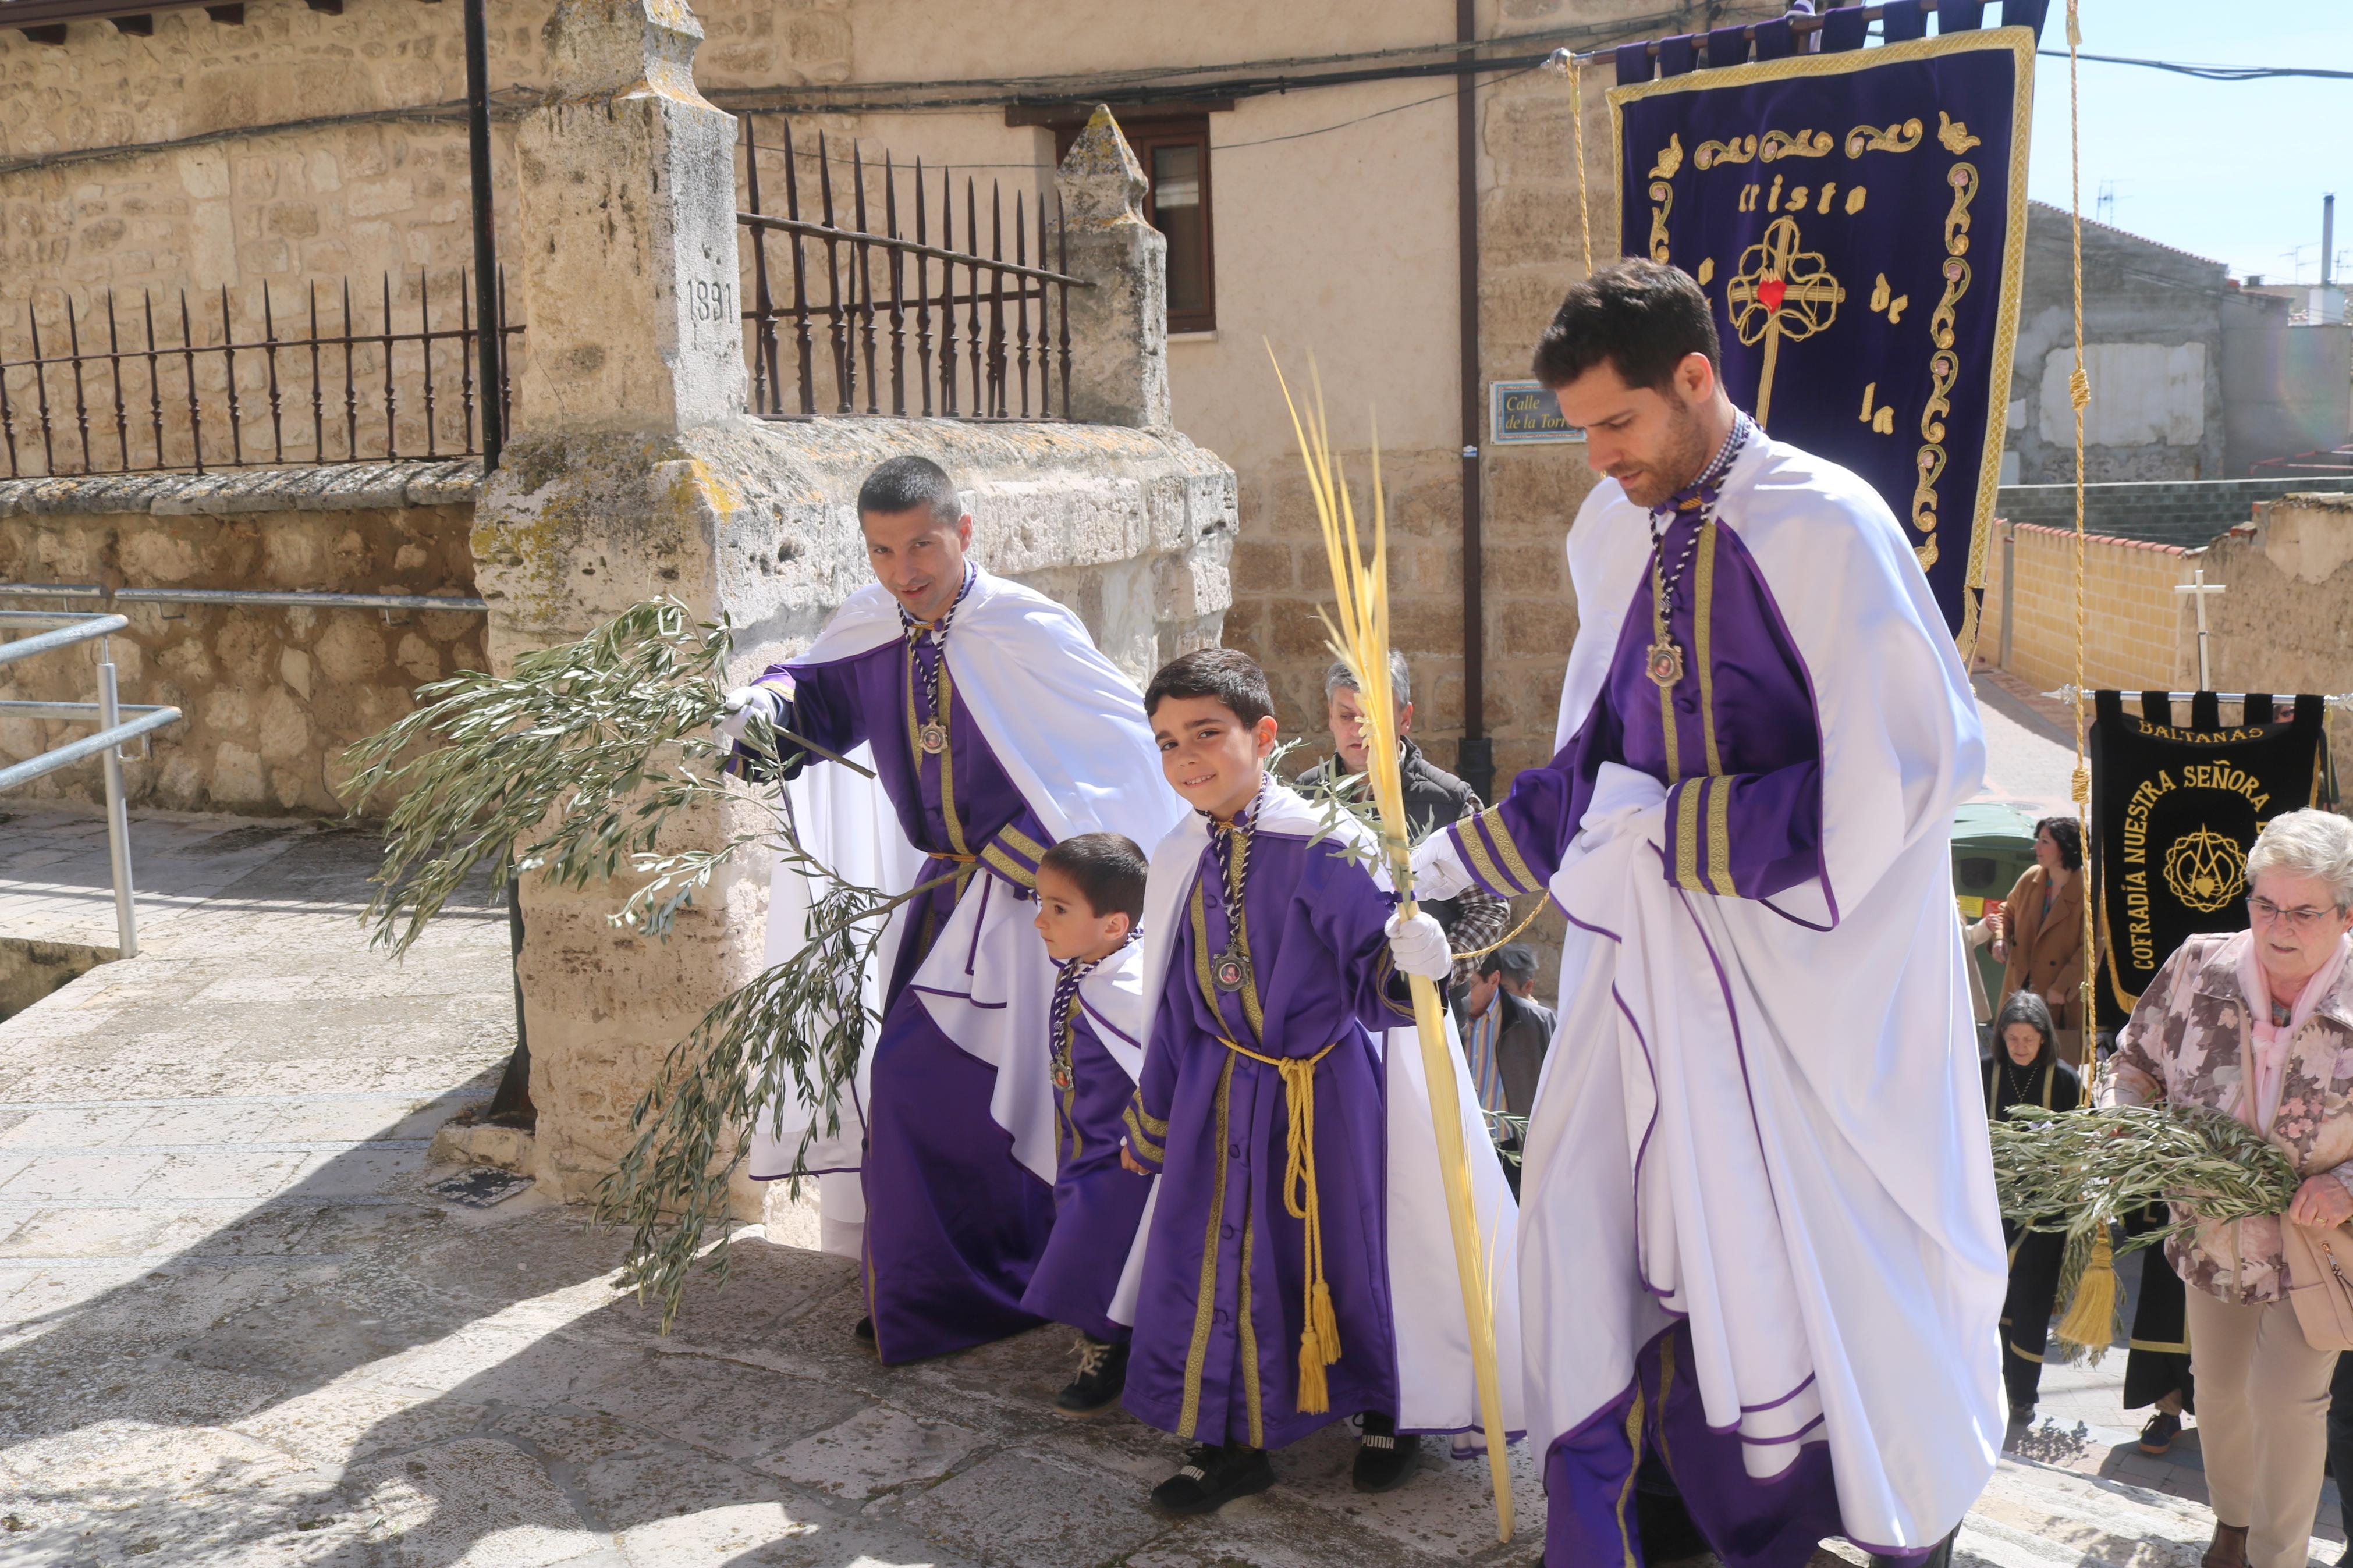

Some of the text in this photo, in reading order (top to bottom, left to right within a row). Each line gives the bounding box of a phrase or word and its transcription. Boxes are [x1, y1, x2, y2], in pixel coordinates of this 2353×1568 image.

[688, 279, 734, 325] 1891
[1506, 395, 1540, 411] Calle
[1506, 414, 1520, 429] de
[1524, 414, 1536, 429] la
[2138, 719, 2263, 743] BALTANAS
[2121, 759, 2270, 970] COFRADÍA NUESTRA SEÑORA
[1361, 1435, 1394, 1449] PUMA
